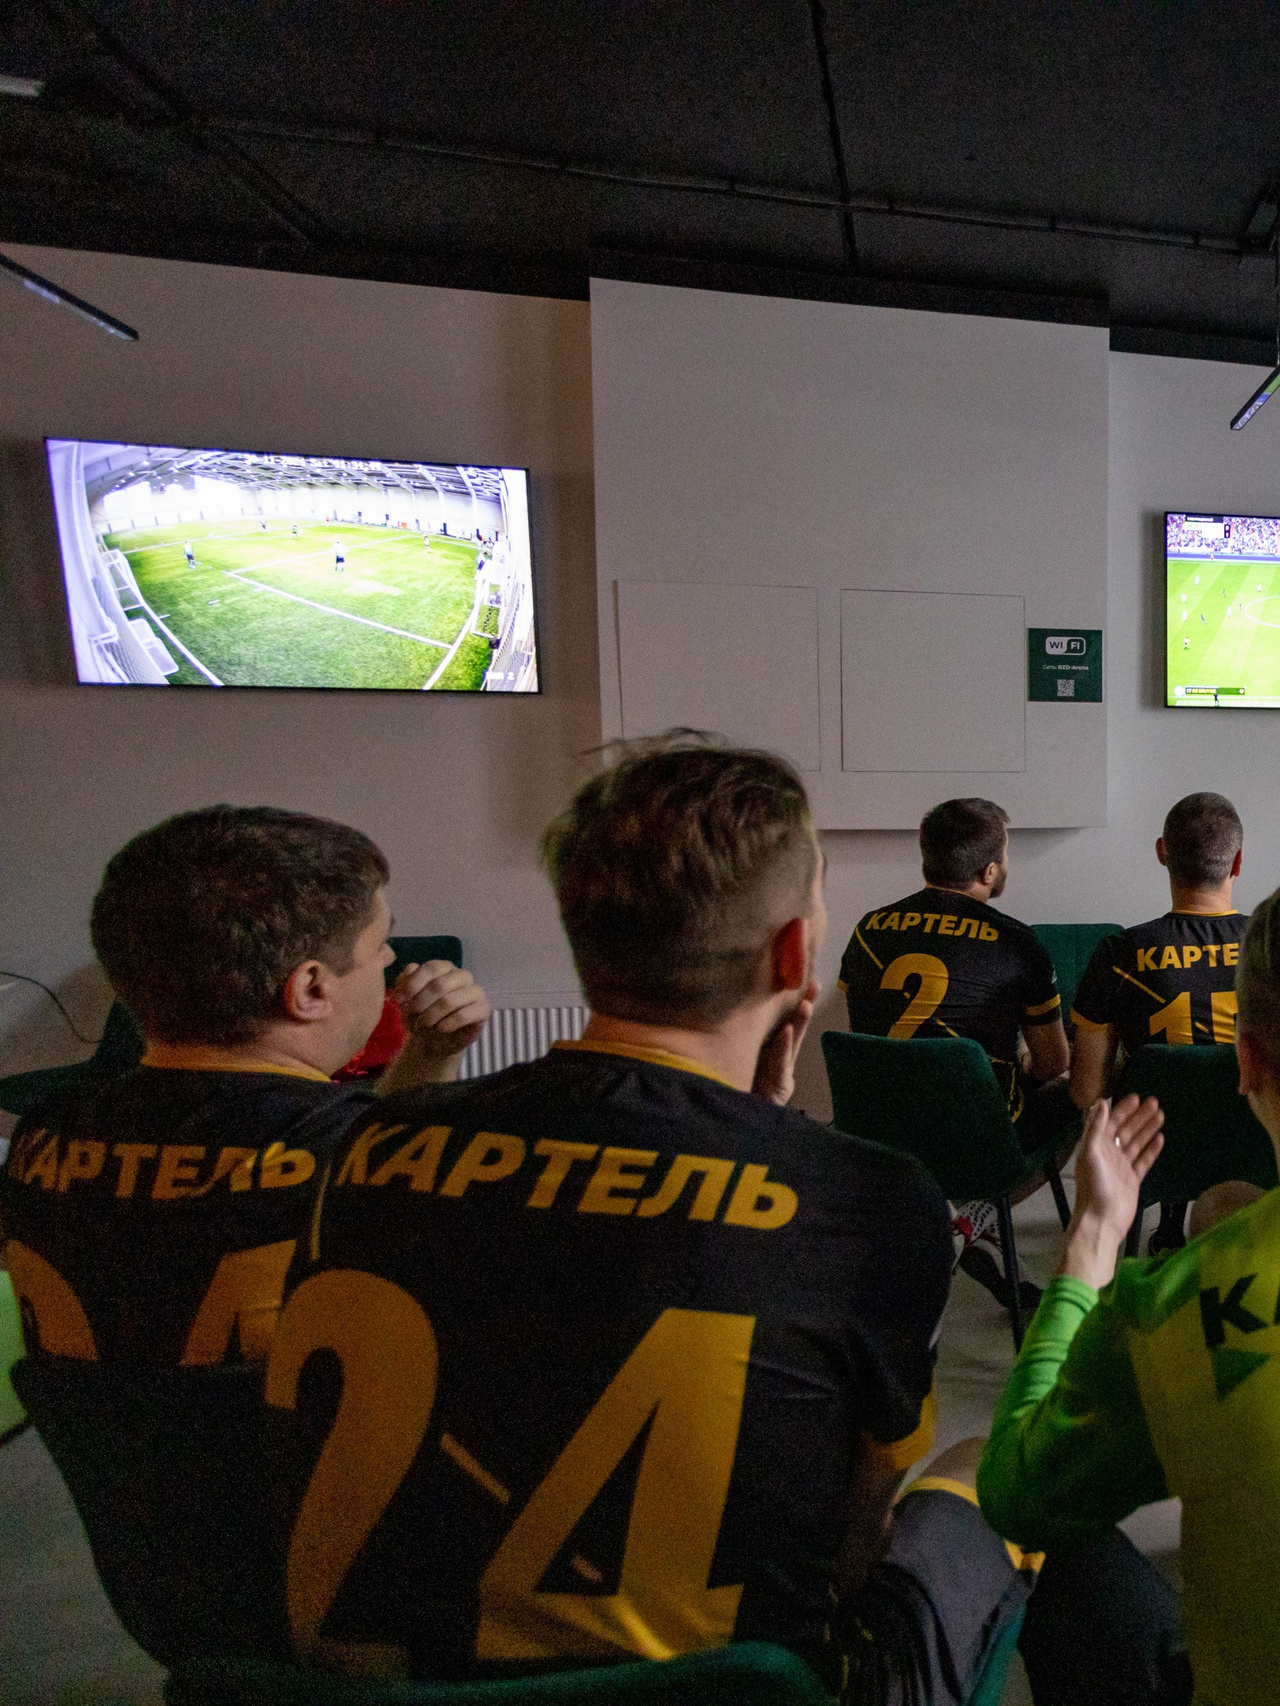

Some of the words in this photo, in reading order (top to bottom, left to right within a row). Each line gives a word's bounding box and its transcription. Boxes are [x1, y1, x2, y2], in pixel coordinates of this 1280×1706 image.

[865, 911, 1000, 942] КАРТЕЛЬ
[1136, 943, 1239, 972] КАРТЕ
[880, 953, 950, 1040] 2
[337, 1123, 799, 1230] КАРТЕЛЬ
[264, 1269, 757, 1678] 24
